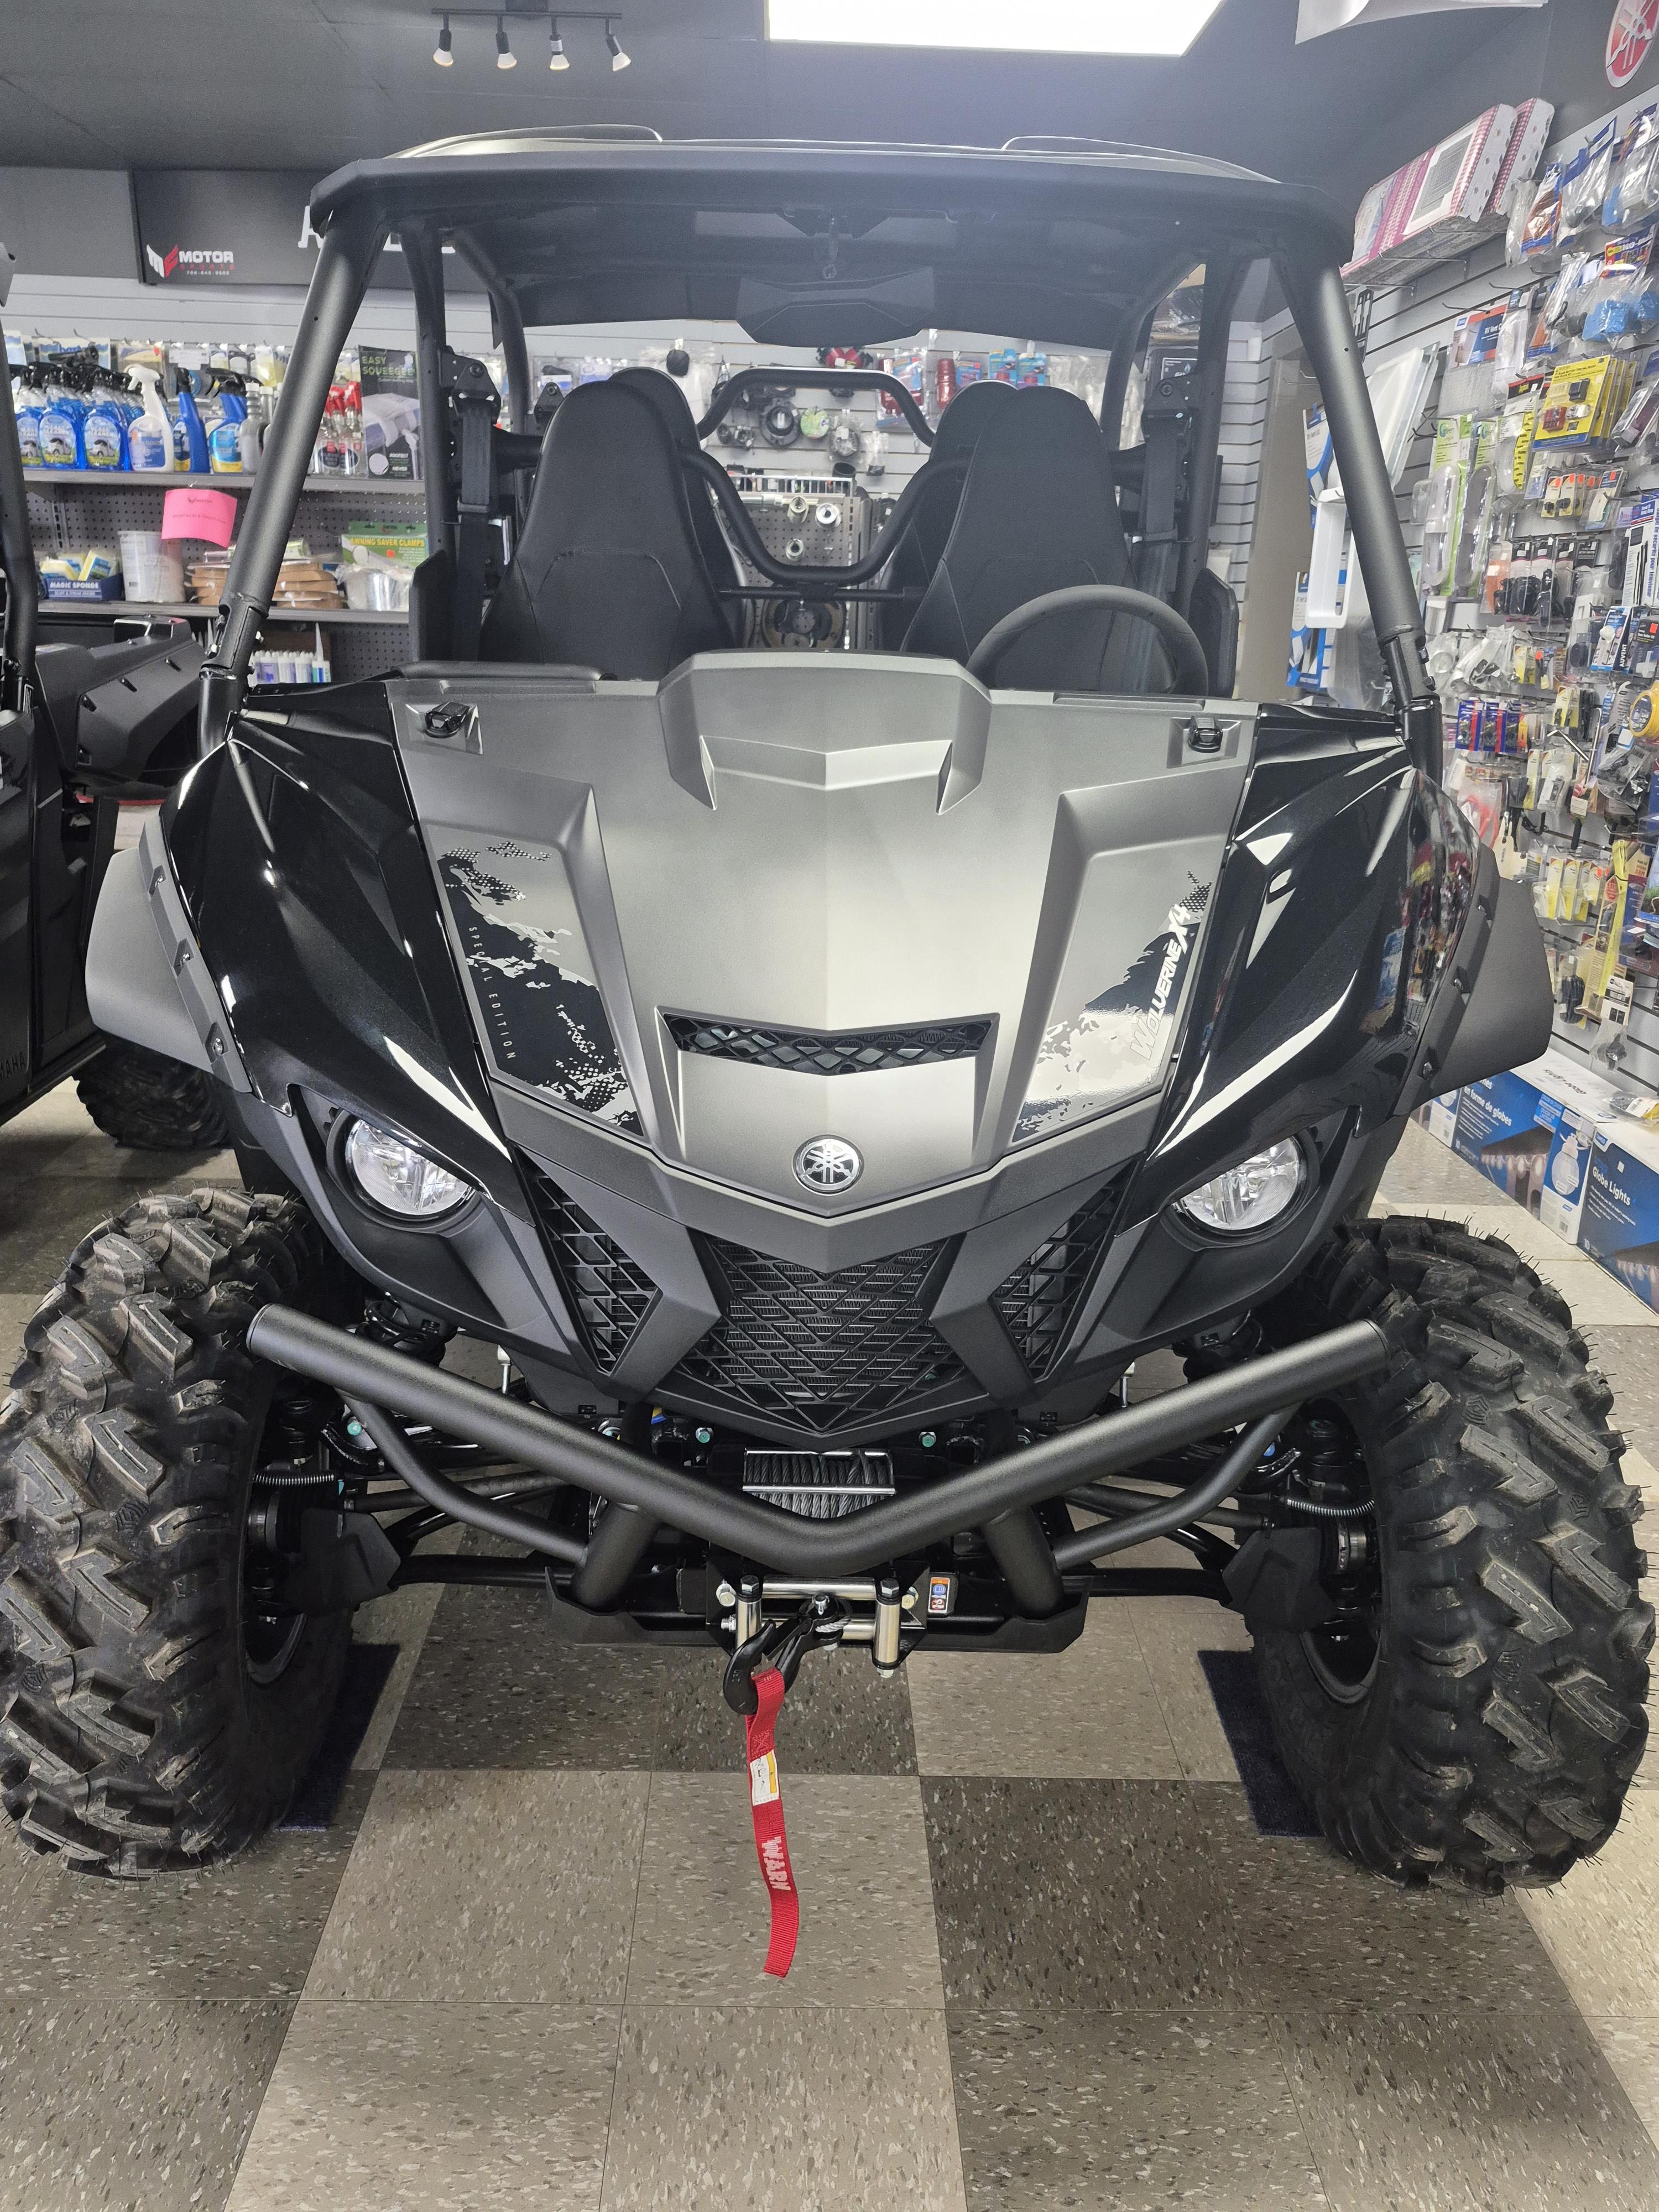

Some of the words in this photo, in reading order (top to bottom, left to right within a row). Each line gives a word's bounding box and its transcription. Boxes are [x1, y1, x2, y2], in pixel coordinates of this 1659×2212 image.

[179, 251, 234, 263] MOTOR
[362, 356, 387, 364] EASY
[350, 537, 376, 546] AWNING
[377, 538, 398, 546] SAVER
[399, 538, 425, 547] CLAMPS
[1619, 644, 1627, 667] AUVENT
[1168, 904, 1191, 954] X4
[469, 926, 492, 982] SPECIAL
[488, 993, 516, 1059] EDITION
[1470, 1089, 1485, 1107] forme
[1485, 1101, 1493, 1112] de
[1493, 1108, 1512, 1126] globes
[1592, 1166, 1609, 1188] Globe
[1609, 1181, 1631, 1206] Lights
[1584, 1238, 1590, 1251] 10
[761, 1836, 791, 1891] WARN
